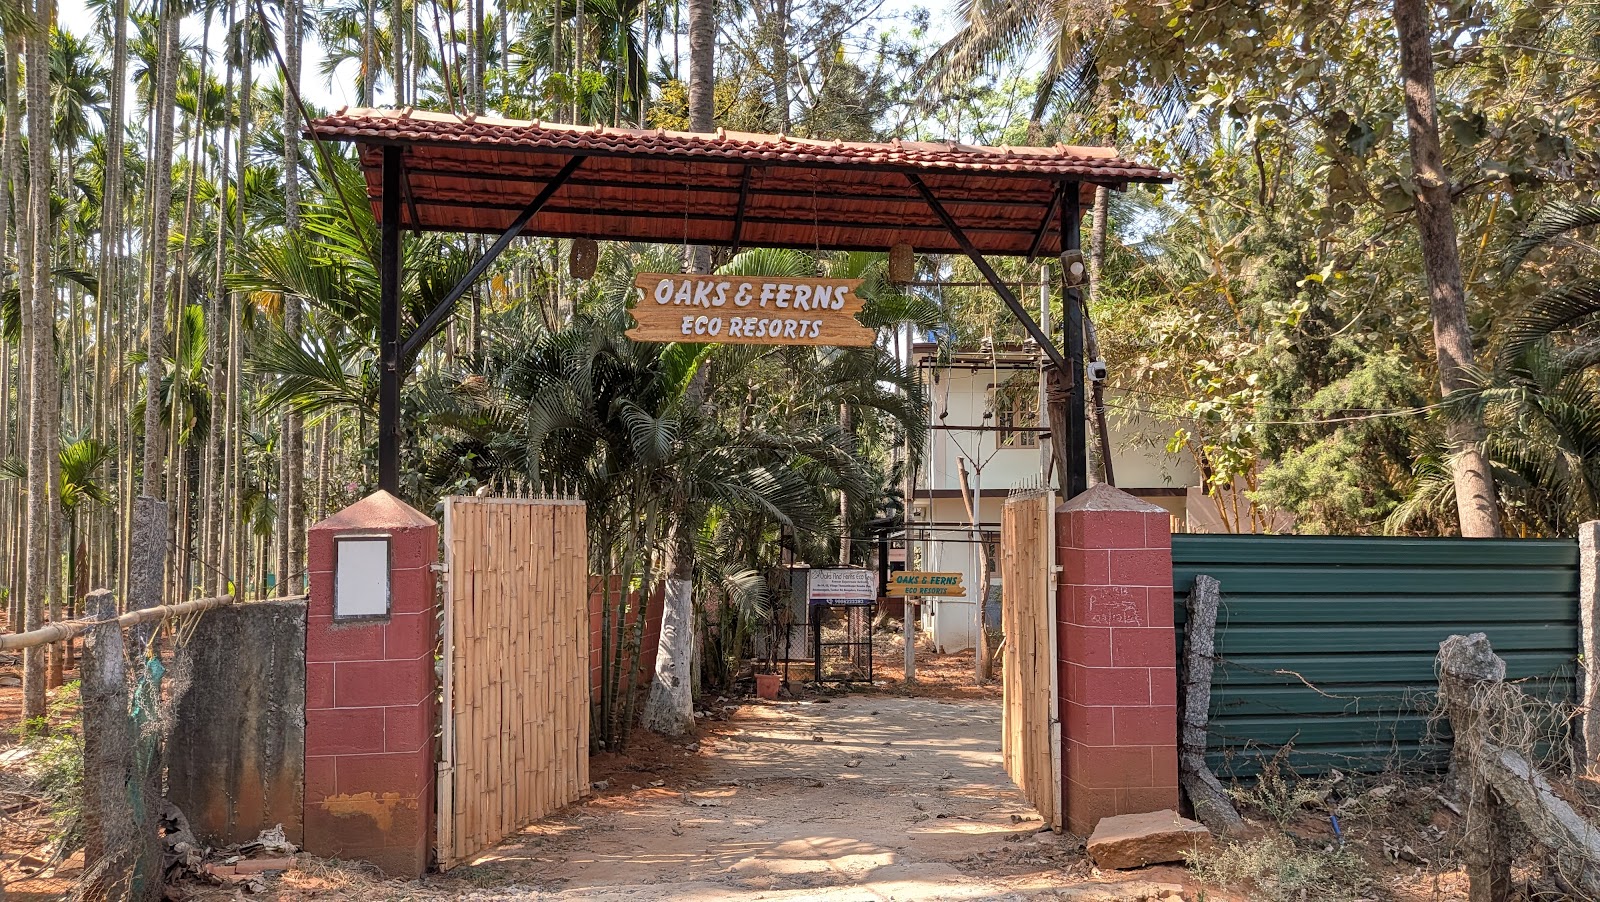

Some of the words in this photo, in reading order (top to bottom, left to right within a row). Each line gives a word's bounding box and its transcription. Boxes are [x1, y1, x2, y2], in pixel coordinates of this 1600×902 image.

[654, 278, 731, 309] OAKS
[734, 282, 753, 307] &
[759, 283, 849, 311] FERNS
[681, 315, 722, 337] ECO
[728, 316, 823, 339] RESORTS
[820, 572, 832, 580] Oaks
[856, 572, 865, 580] Eco
[896, 575, 919, 584] OAKS
[921, 576, 927, 584] &
[930, 576, 958, 585] FERNS
[919, 587, 948, 595] RESORTS
